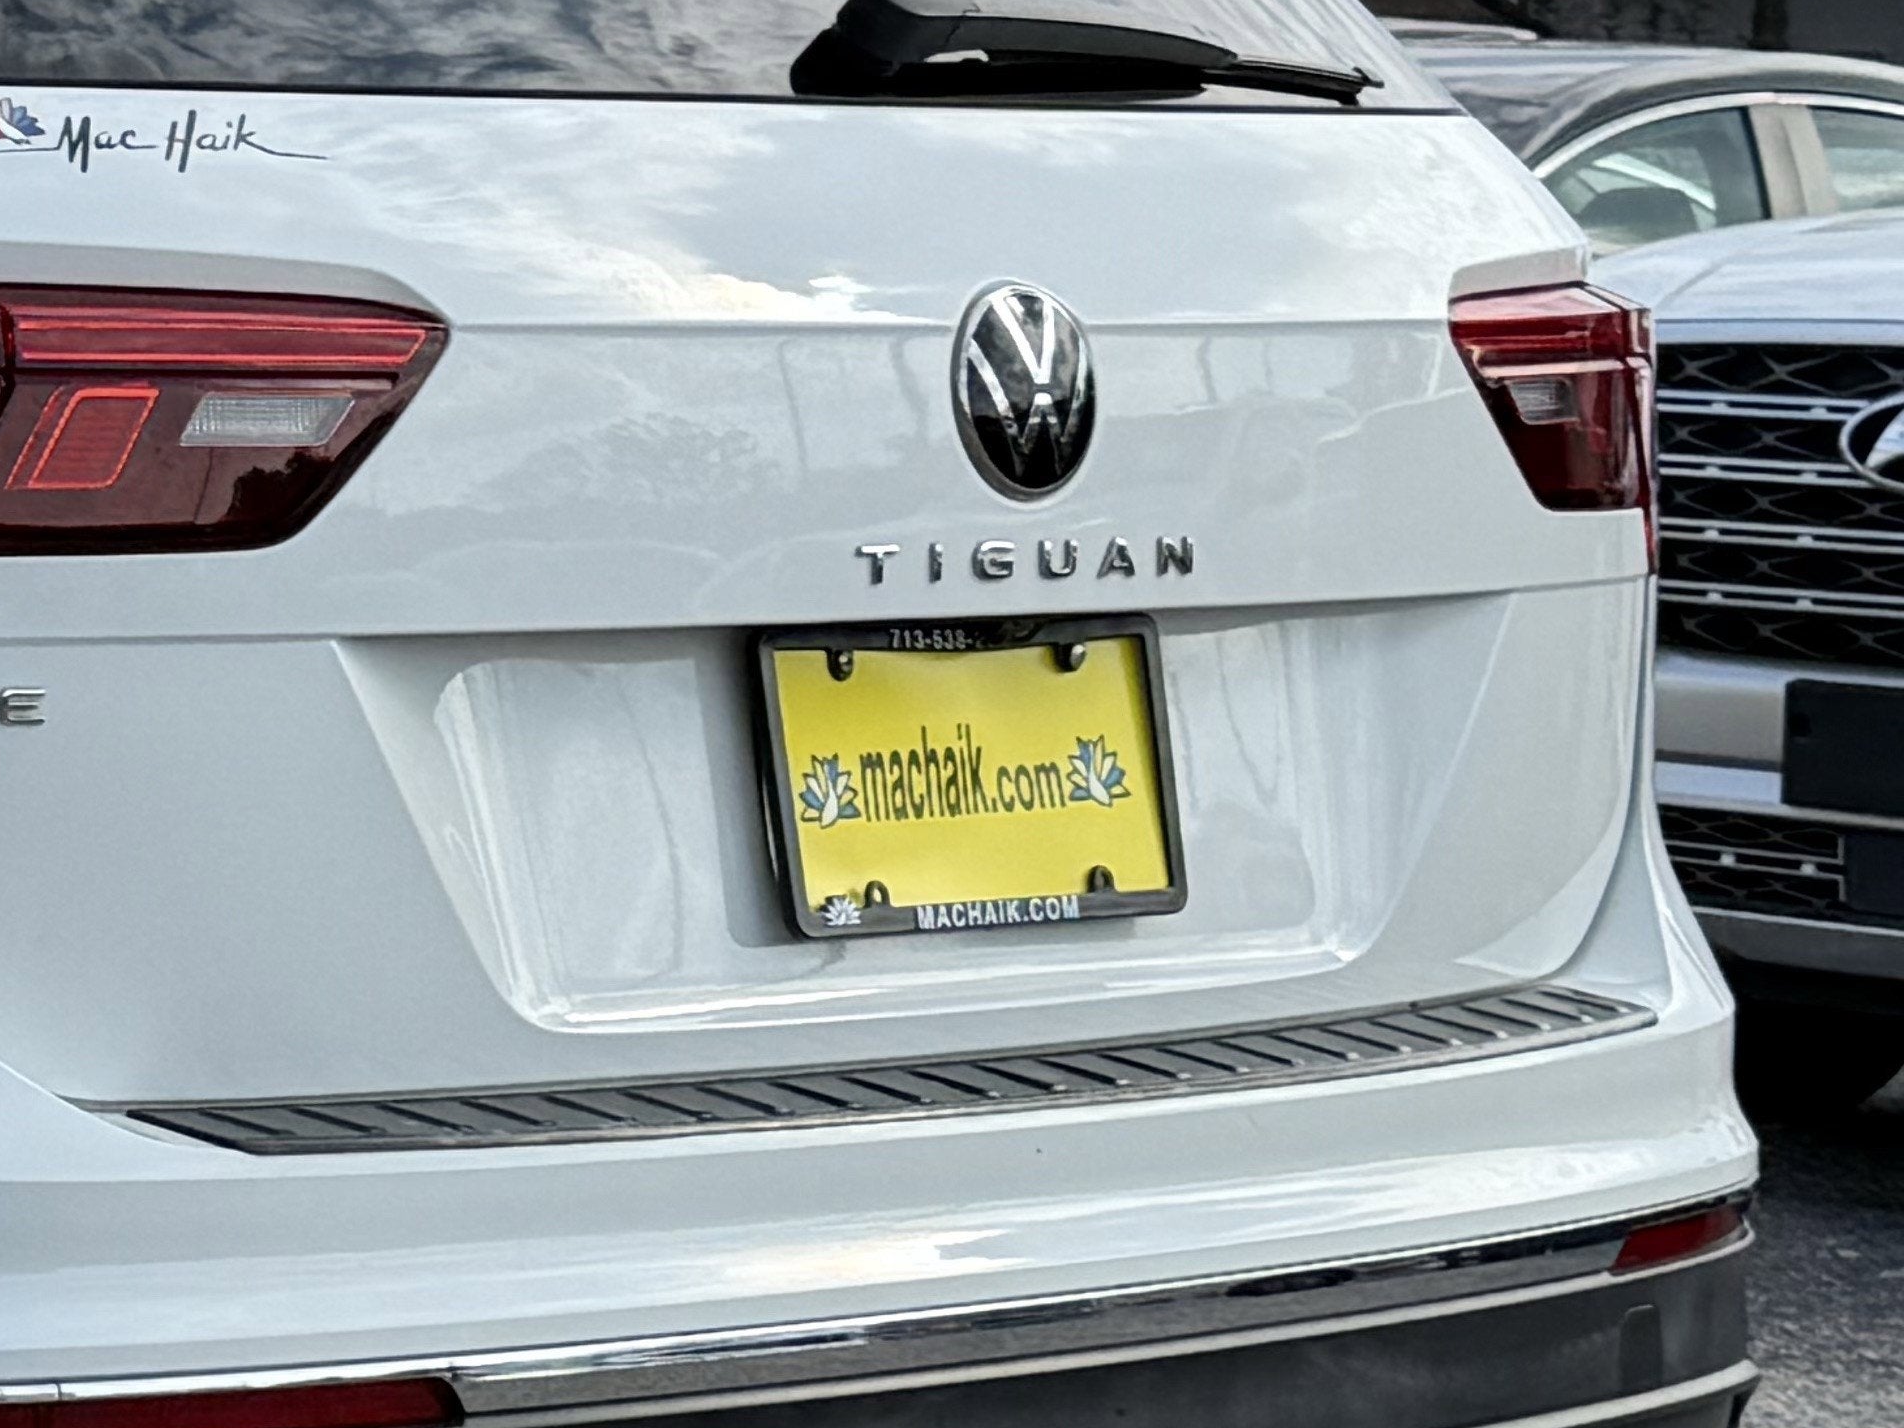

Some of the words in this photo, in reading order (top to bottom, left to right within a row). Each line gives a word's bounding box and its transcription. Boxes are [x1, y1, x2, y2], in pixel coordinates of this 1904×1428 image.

[164, 109, 328, 174] Haik
[854, 535, 1194, 585] TIGUAN
[859, 722, 1067, 822] machaik.com
[916, 894, 1081, 930] MACHAIK.COM
